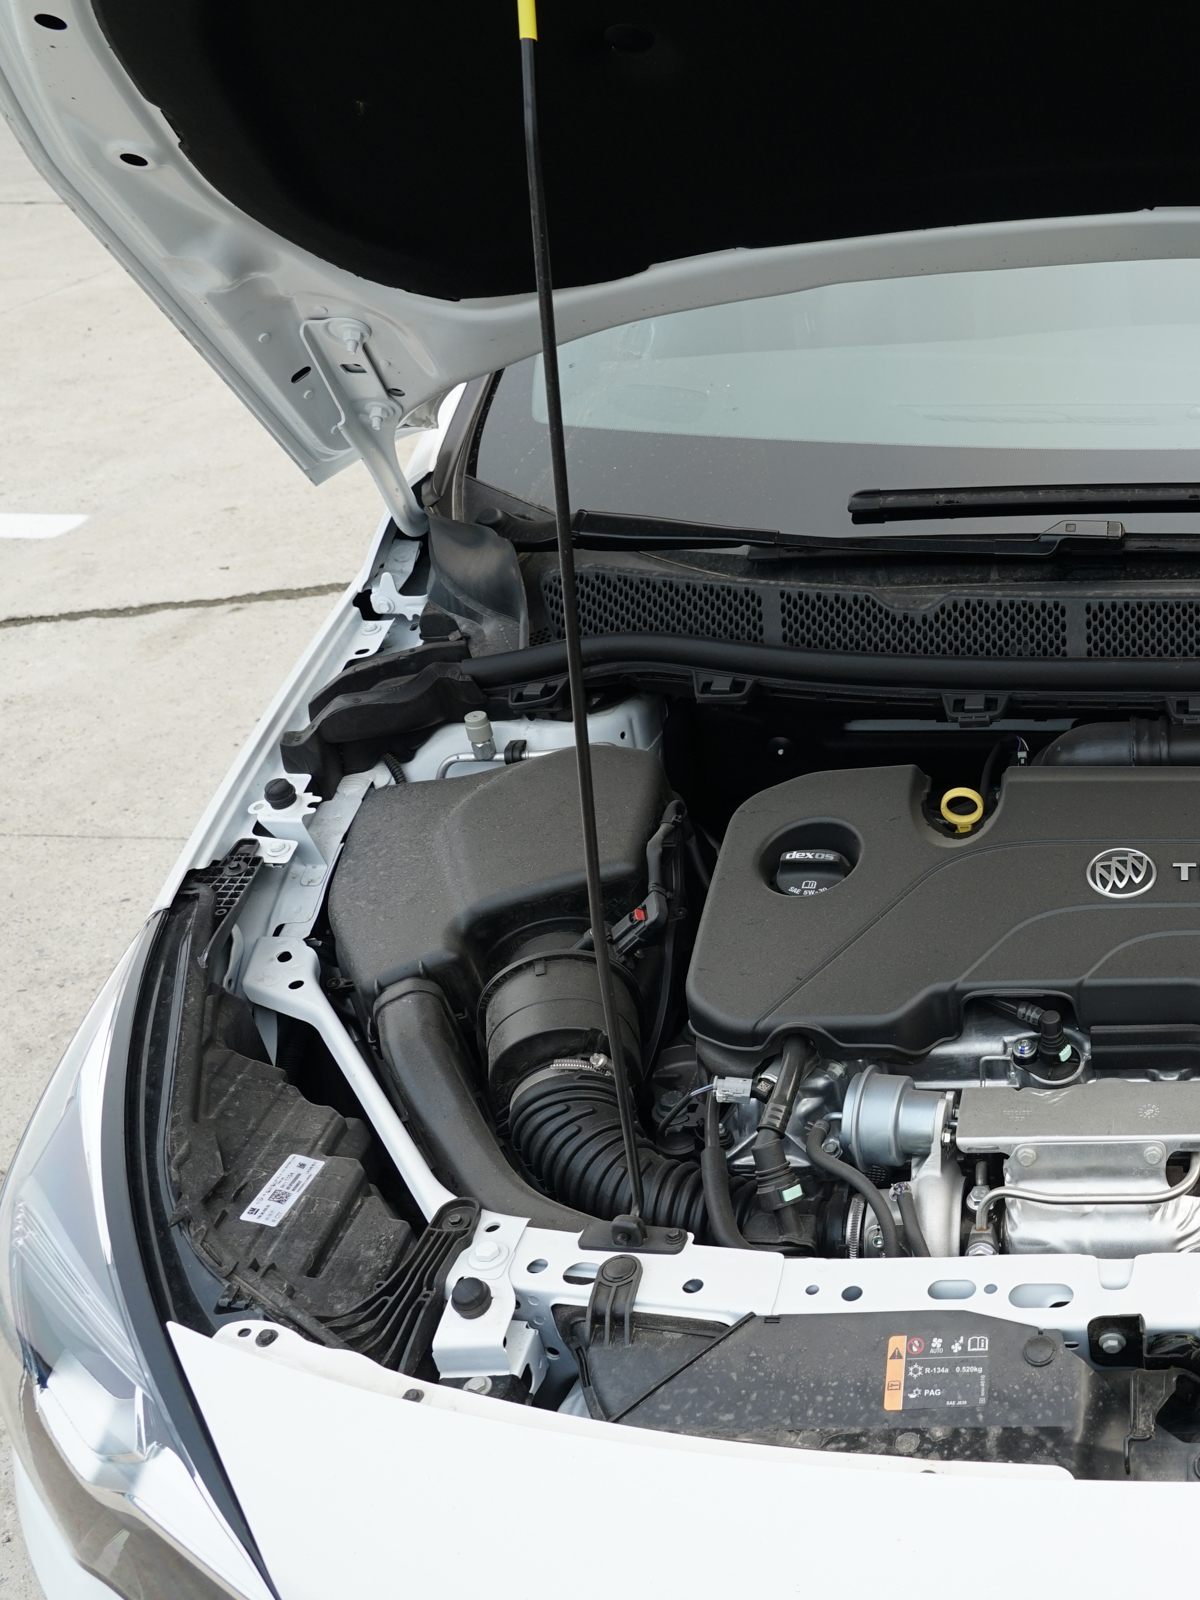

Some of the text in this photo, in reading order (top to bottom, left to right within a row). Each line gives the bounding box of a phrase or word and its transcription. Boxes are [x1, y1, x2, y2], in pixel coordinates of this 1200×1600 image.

[785, 851, 835, 861] dexos
[788, 886, 801, 895] SAE
[955, 1366, 983, 1374] 0.520kg
